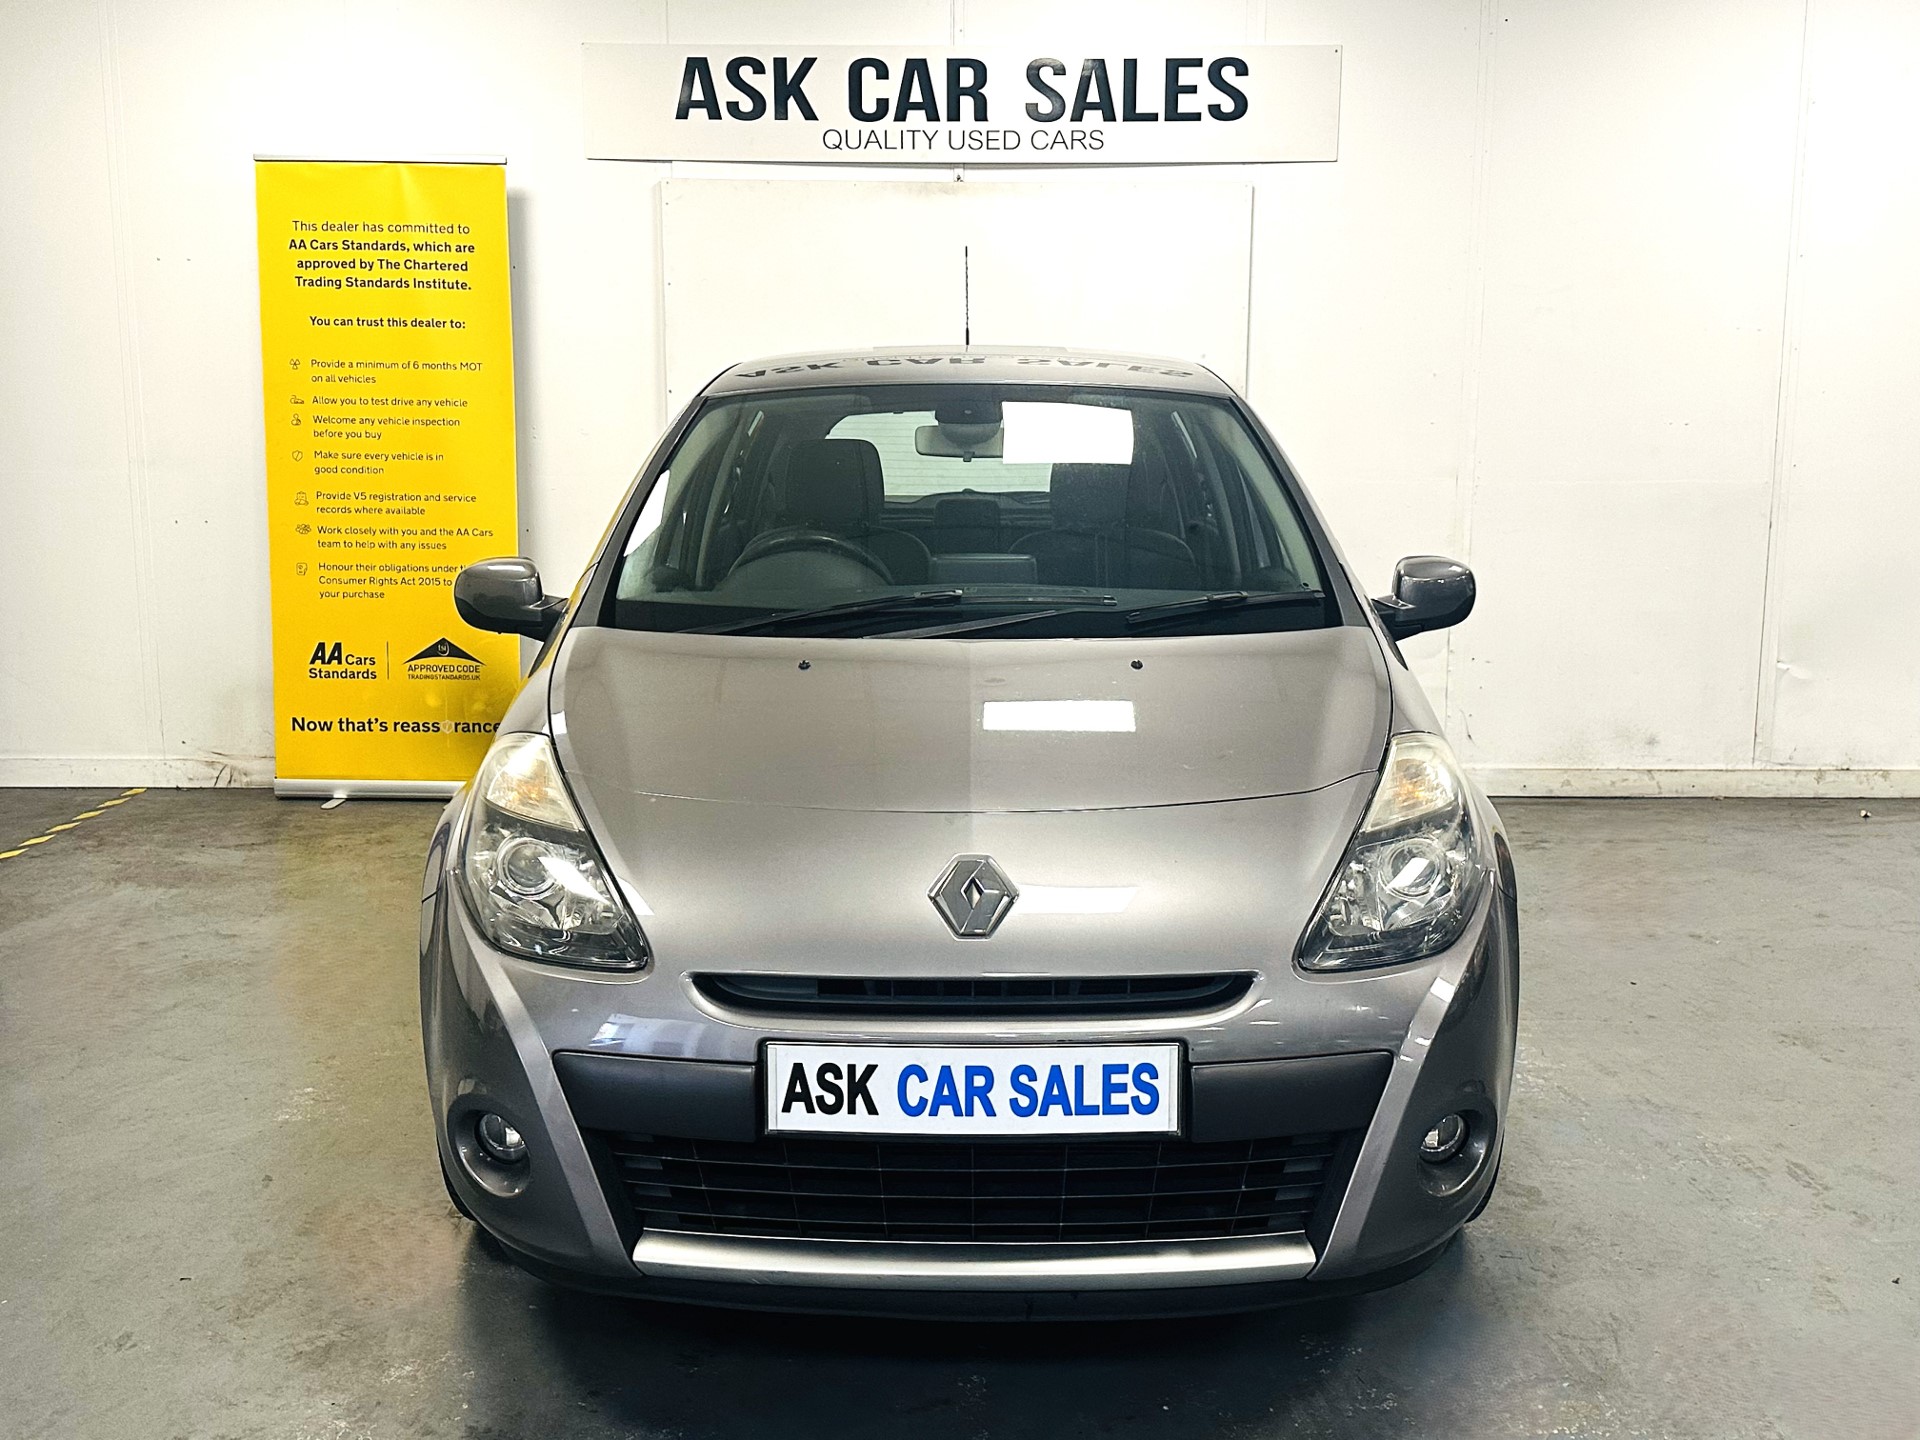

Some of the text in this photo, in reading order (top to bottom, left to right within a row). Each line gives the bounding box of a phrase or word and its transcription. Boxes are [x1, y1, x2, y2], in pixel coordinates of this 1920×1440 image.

[675, 56, 1249, 122] ASK CAR SALES
[822, 129, 1105, 151] QUALITY USED CARS
[292, 221, 470, 234] This dealer has committed to
[289, 239, 475, 253] AA Cars Standards, which are
[297, 259, 468, 271] approved by The Chartered
[295, 277, 472, 290] Trading Standards Institute.
[310, 316, 466, 328] You can trust this dealer to:
[311, 360, 345, 368] Provide
[356, 361, 399, 369] minimum
[402, 361, 411, 369] of
[413, 361, 419, 369] 6
[422, 362, 457, 370] months
[460, 362, 482, 371] MOT
[311, 375, 376, 383] on all vehicles
[312, 396, 337, 405] Allow
[340, 398, 355, 406] you
[391, 398, 413, 406] drive
[416, 399, 432, 407] any
[434, 399, 468, 407] vehicle
[313, 415, 460, 426] Welcome any vehicle inspection
[345, 431, 362, 440] you
[365, 430, 382, 440] buy
[314, 451, 339, 459] Make
[364, 453, 389, 461] every
[392, 452, 424, 460] vehicle
[426, 453, 434, 461] is
[436, 453, 443, 461] in
[314, 466, 384, 475] good condition
[316, 492, 351, 500] Provide
[353, 492, 367, 500] V5
[369, 492, 421, 502] registration
[443, 494, 476, 502] service
[317, 506, 425, 515] records where available
[317, 526, 342, 534] Work
[345, 527, 376, 536] closely
[401, 529, 418, 537] you
[420, 528, 437, 536] and
[439, 528, 454, 536] the
[472, 529, 494, 537] Cars
[318, 540, 341, 548] team
[356, 540, 375, 550] help
[378, 541, 397, 549] with
[400, 542, 416, 551] any
[419, 542, 447, 550] issues
[319, 563, 353, 572] Honour
[356, 564, 376, 572] their
[379, 564, 429, 573] obligations
[319, 576, 453, 587] Consumer Rights Act 2015 to
[320, 590, 385, 599] your purchase
[310, 642, 376, 666] AA Cars
[309, 668, 377, 679] Standards
[456, 665, 480, 673] CODE
[291, 717, 333, 732] Now
[338, 718, 388, 732] that's
[781, 1062, 1159, 1117] ASK CAR SALES
